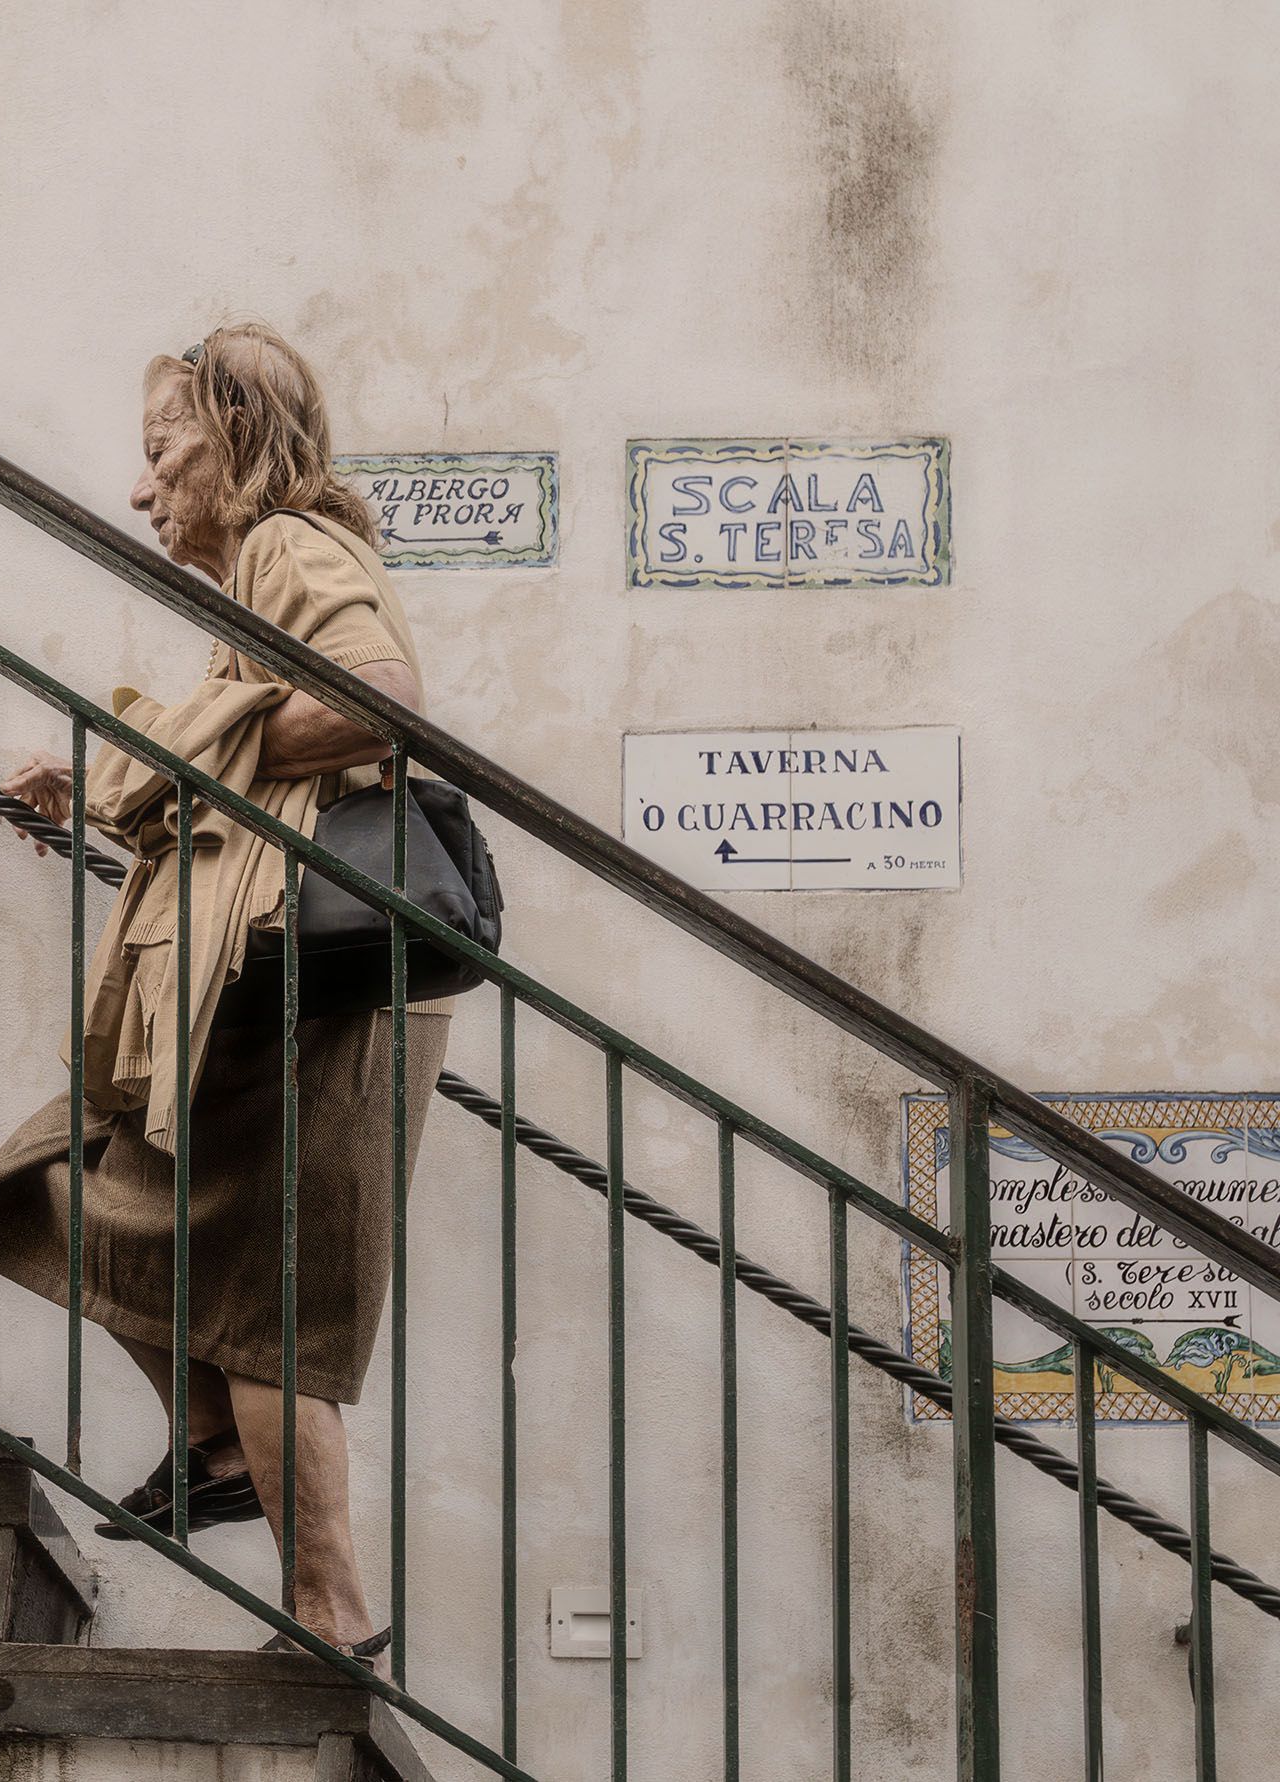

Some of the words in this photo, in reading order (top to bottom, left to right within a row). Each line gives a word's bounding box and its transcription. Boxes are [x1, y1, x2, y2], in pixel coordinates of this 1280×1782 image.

[363, 478, 510, 501] ALBERGO
[671, 473, 884, 517] SCALA
[413, 503, 525, 526] PRORA
[658, 523, 704, 563] S.
[698, 749, 890, 775] TAVERNA
[677, 799, 943, 831] GUARRACINO
[883, 855, 906, 870] 30
[909, 860, 947, 870] METRI
[1085, 1282, 1174, 1311] secolo
[1188, 1290, 1238, 1309] XVII
